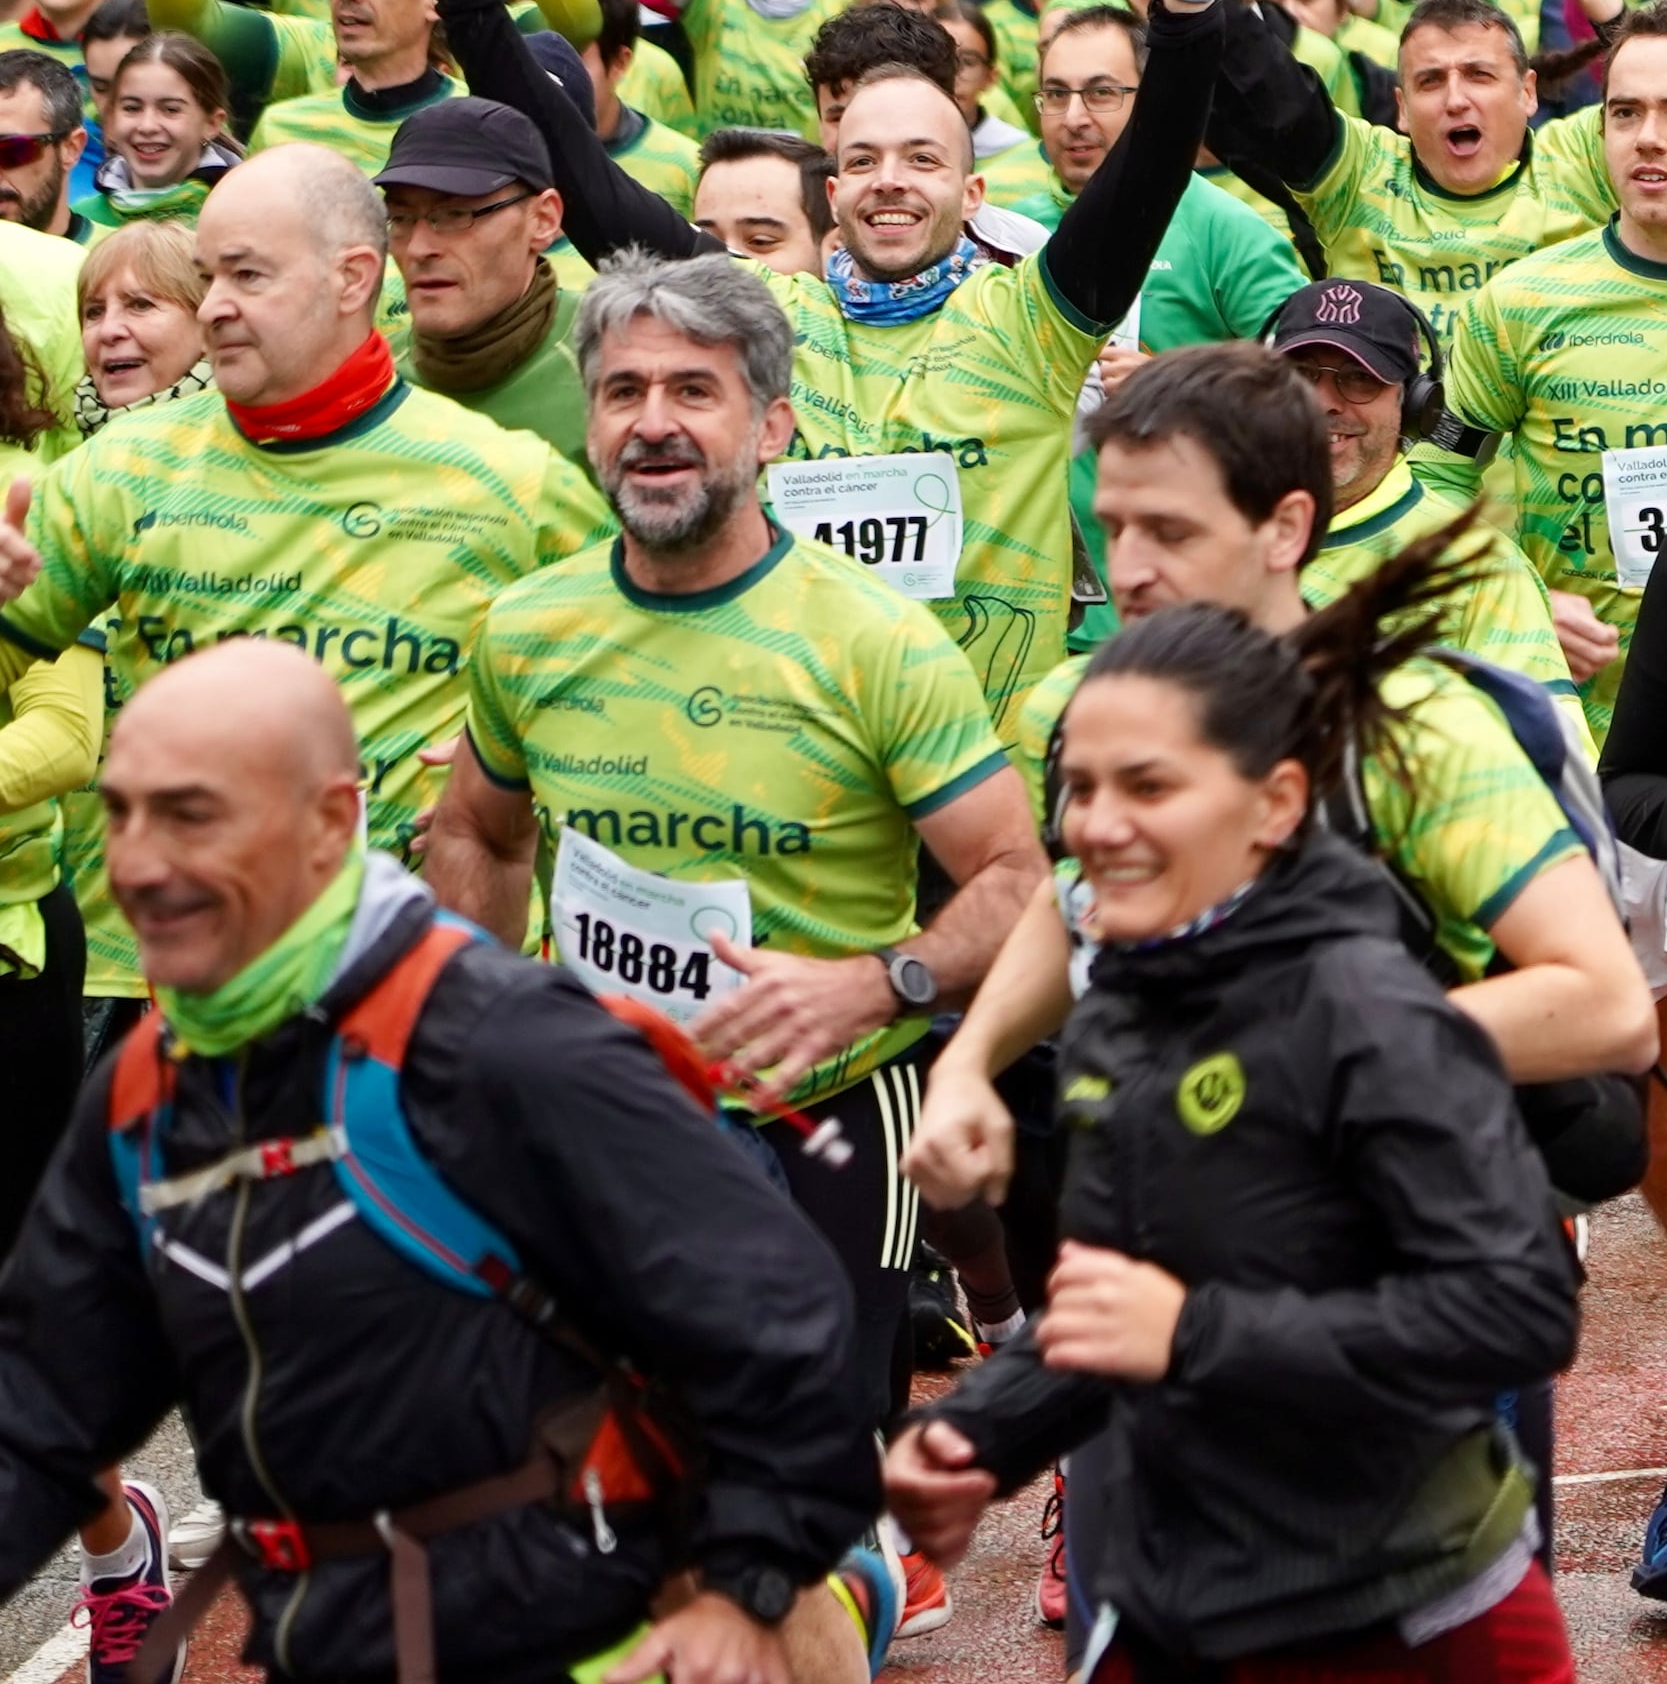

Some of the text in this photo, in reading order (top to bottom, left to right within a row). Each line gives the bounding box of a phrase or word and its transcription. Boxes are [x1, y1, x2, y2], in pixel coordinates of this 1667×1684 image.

[1550, 382, 1577, 400] XIII
[1553, 418, 1609, 452] En
[783, 467, 908, 486] Valladolid en marcha
[1618, 473, 1657, 484] contra
[784, 481, 878, 497] contra el cáncer
[1558, 512, 1596, 556] el
[168, 571, 302, 593] Valladolid
[566, 803, 811, 856] marcha
[575, 912, 711, 1000] 18884
